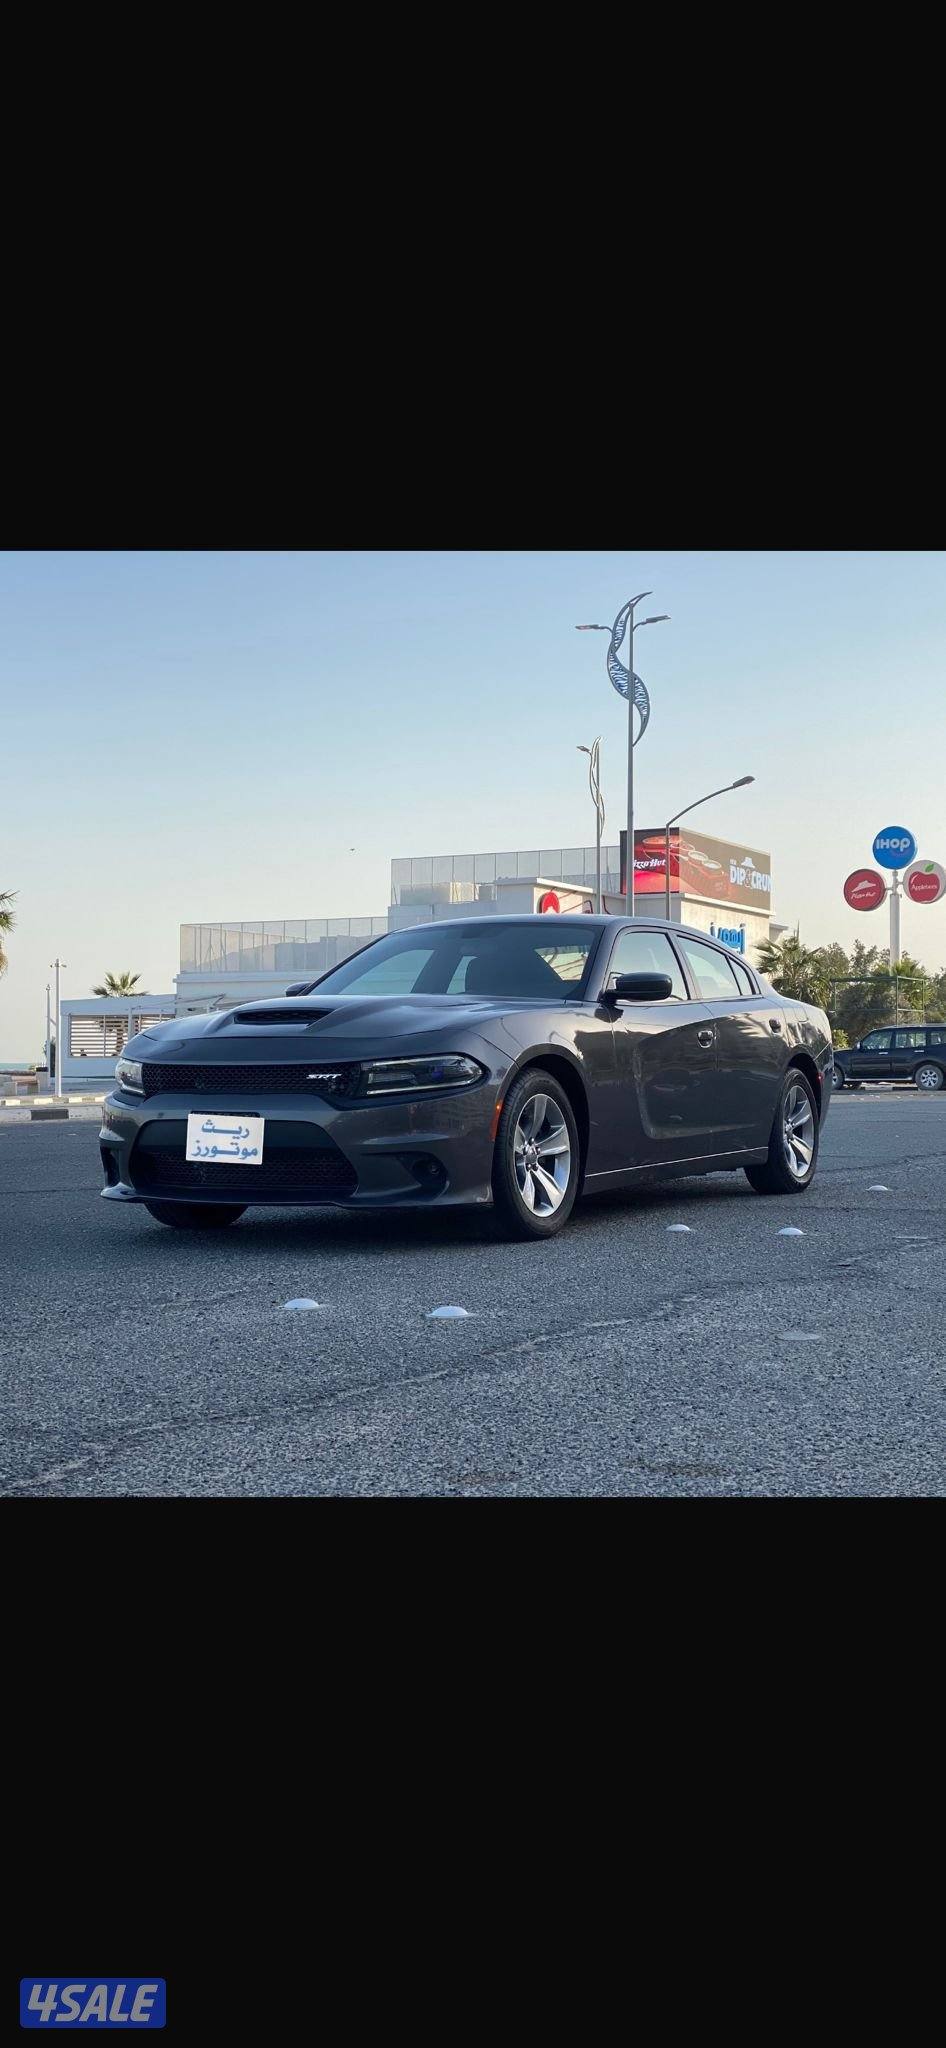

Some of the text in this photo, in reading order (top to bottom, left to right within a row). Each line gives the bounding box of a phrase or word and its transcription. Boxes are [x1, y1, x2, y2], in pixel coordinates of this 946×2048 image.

[876, 838, 911, 852] IHOP
[633, 860, 650, 869] izza
[730, 865, 746, 886] DIP
[191, 1140, 259, 1160] موتورز
